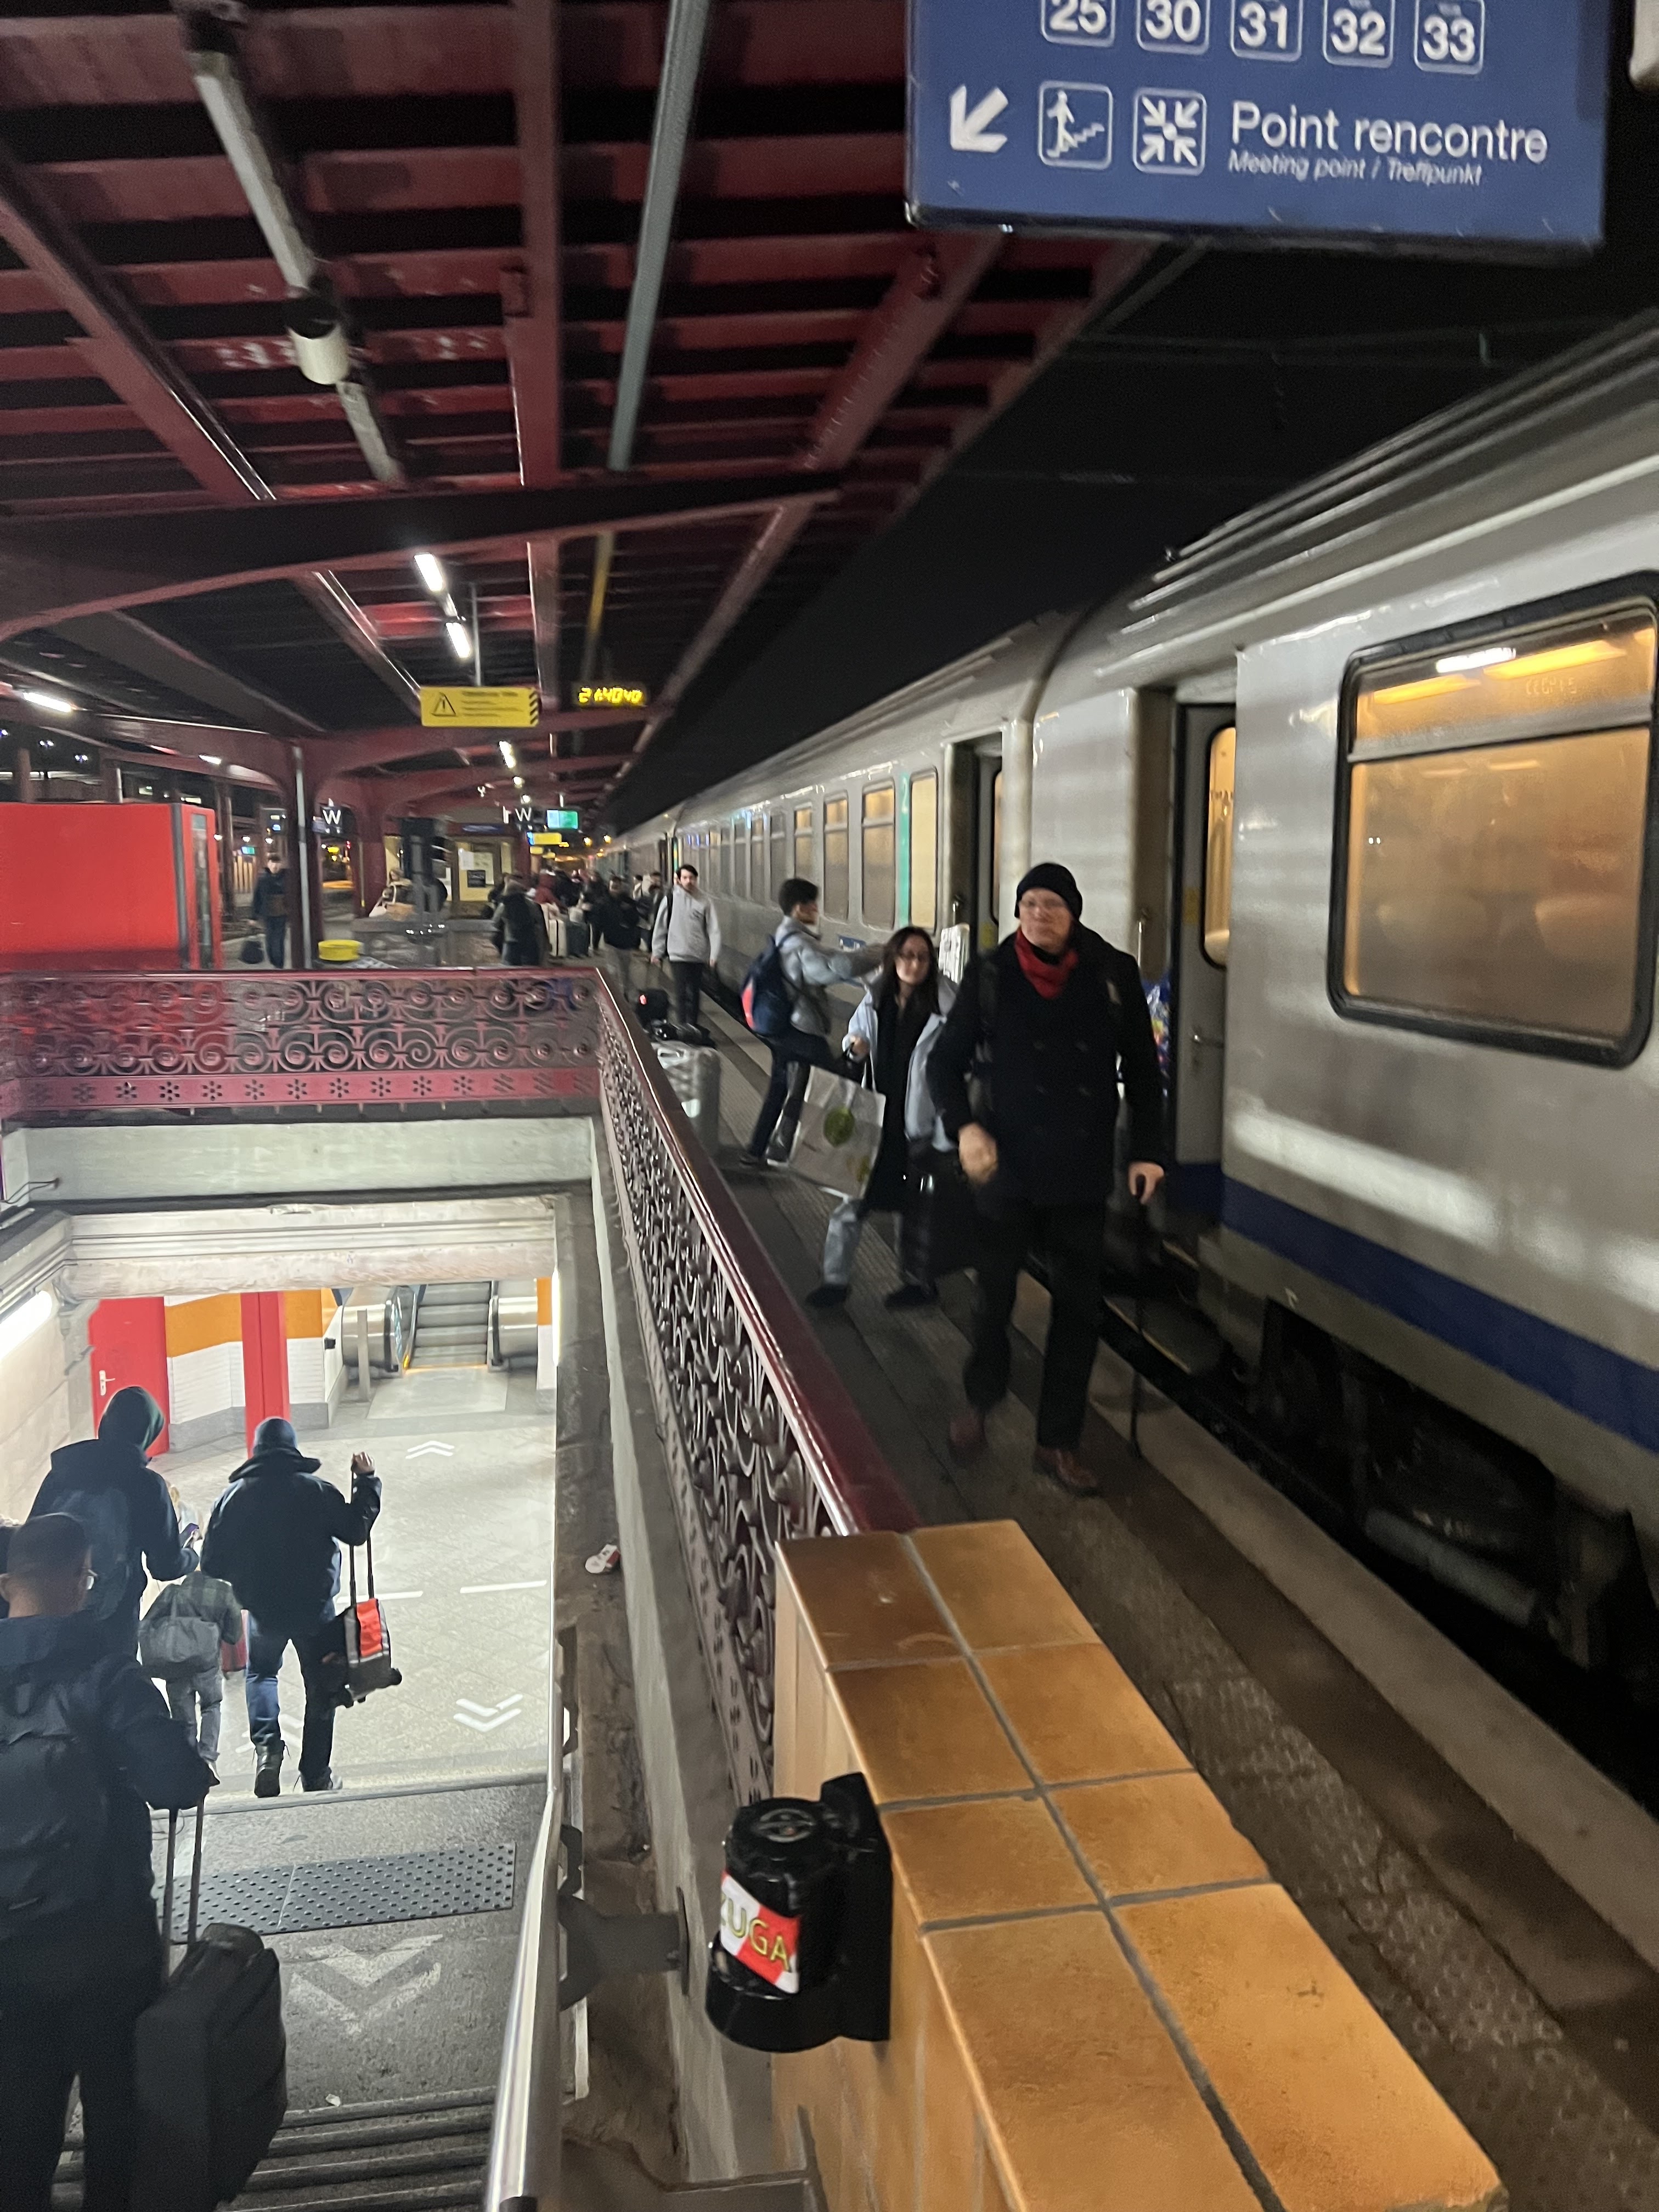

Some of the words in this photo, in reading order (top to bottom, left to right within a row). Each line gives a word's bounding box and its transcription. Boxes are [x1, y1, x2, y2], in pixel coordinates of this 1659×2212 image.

[1049, 0, 1107, 35] 25
[1145, 0, 1201, 43] 30
[1238, 2, 1287, 49] 31
[1330, 8, 1386, 55] 32
[1423, 14, 1476, 62] 33
[1232, 99, 1340, 151] Point
[1354, 118, 1548, 164] rencontre
[1228, 148, 1310, 183] Meeting
[1313, 156, 1366, 182] point
[1387, 155, 1482, 187] Treffpunkt
[322, 809, 341, 825] W
[515, 806, 532, 822] W
